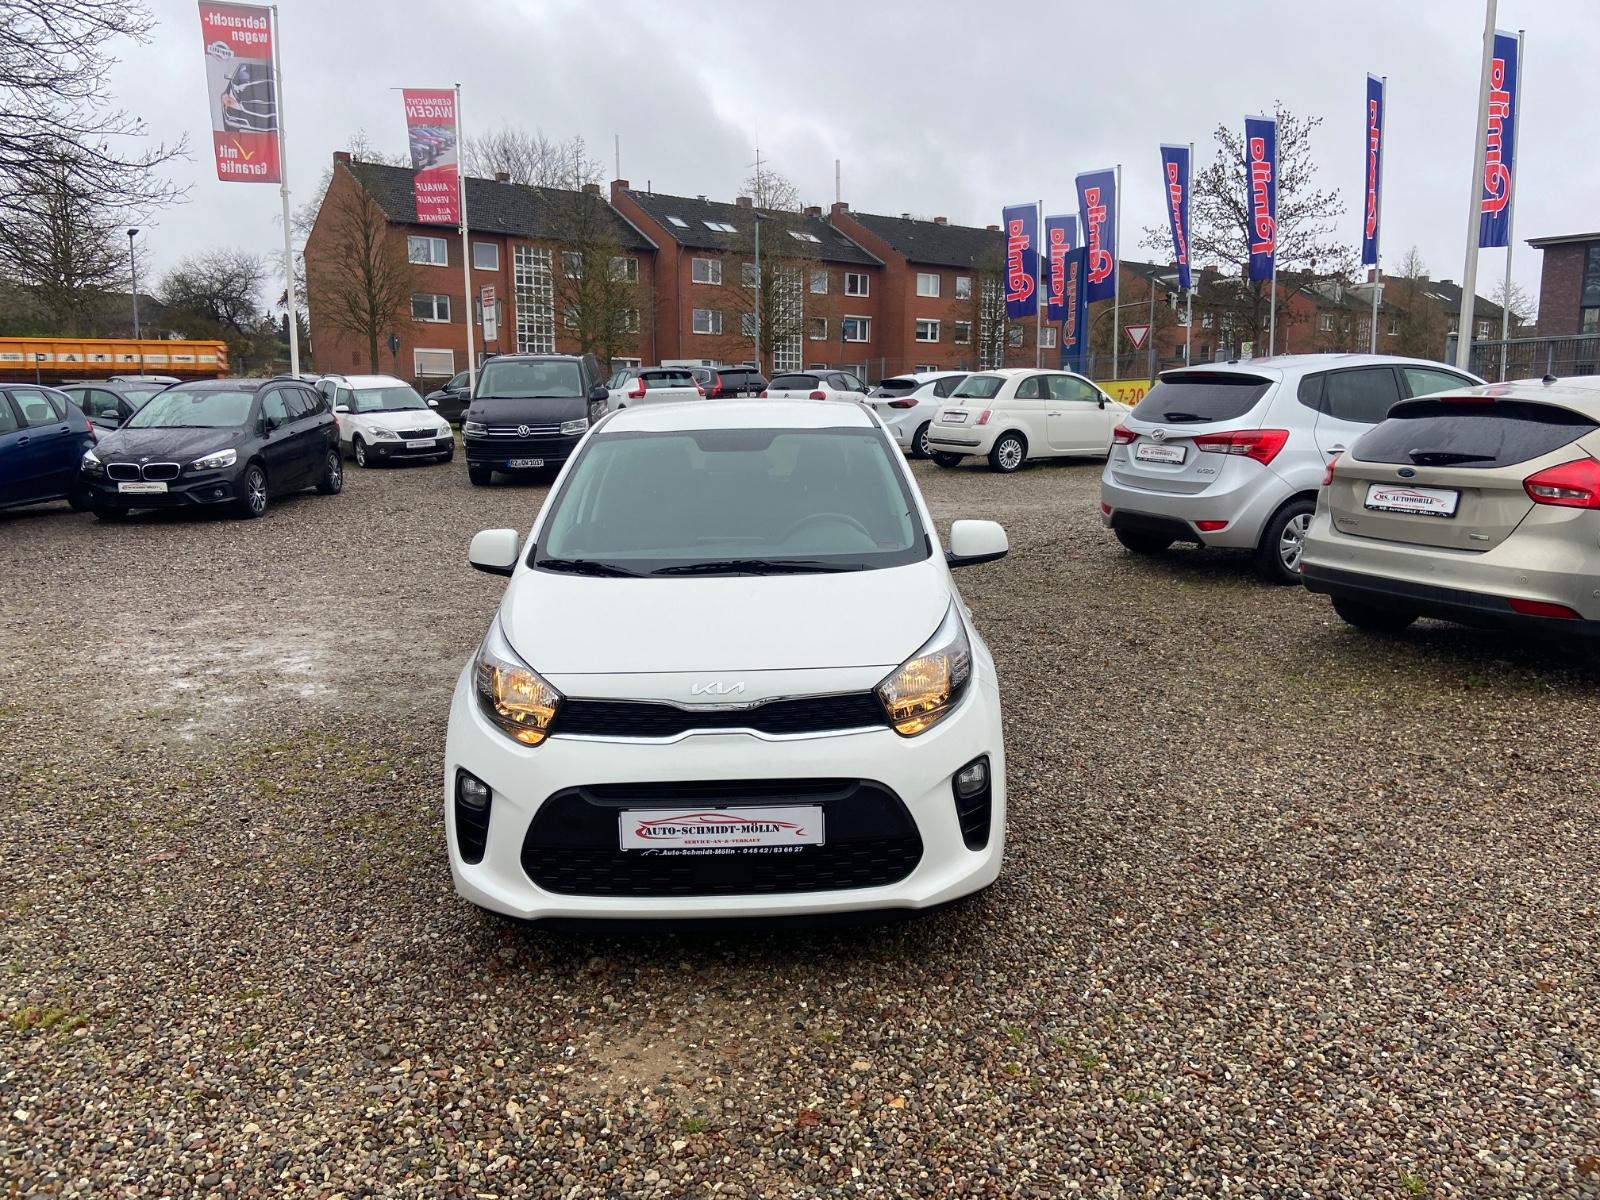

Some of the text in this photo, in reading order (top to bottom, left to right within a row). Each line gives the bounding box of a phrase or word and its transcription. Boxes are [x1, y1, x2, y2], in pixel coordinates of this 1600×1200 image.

[1063, 261, 1079, 346] famila
[1392, 495, 1434, 505] AUTOMOBILE
[643, 822, 780, 837] AUTO-SCHMIDT-MÖLLN
